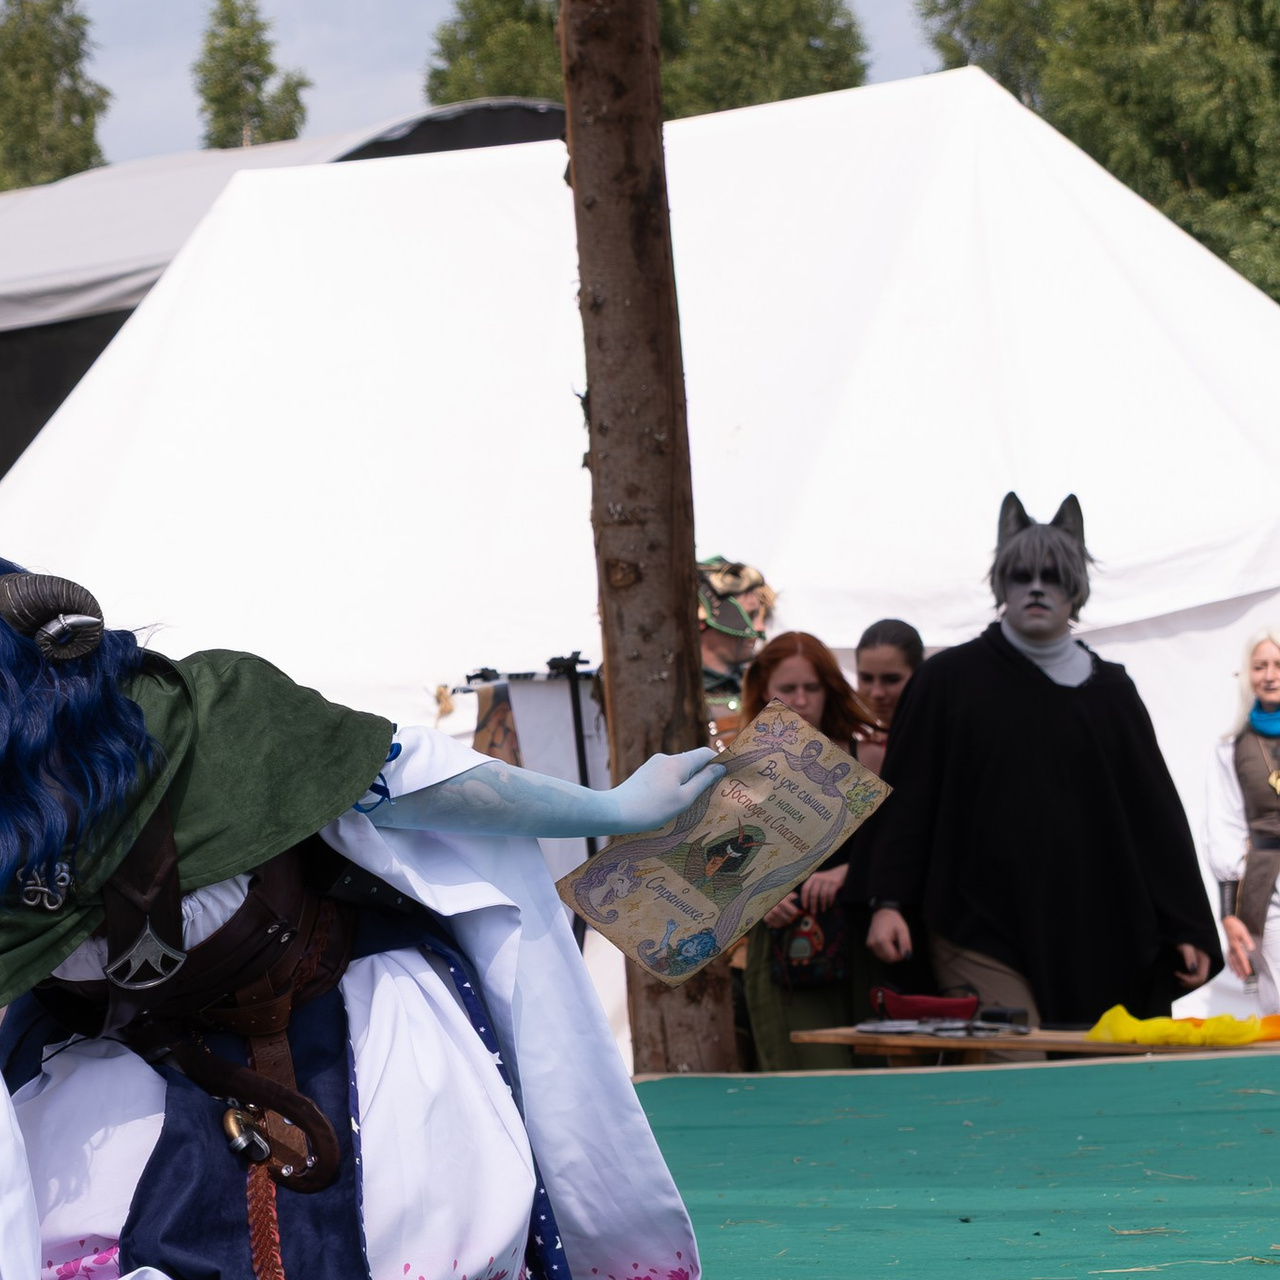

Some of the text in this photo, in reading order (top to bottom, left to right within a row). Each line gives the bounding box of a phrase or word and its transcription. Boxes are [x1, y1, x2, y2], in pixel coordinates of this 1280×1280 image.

[721, 779, 811, 853] Господе и Спасителе
[757, 760, 834, 821] Вы уже слышали
[767, 794, 806, 823] о нашем
[645, 876, 716, 925] Страннике?
